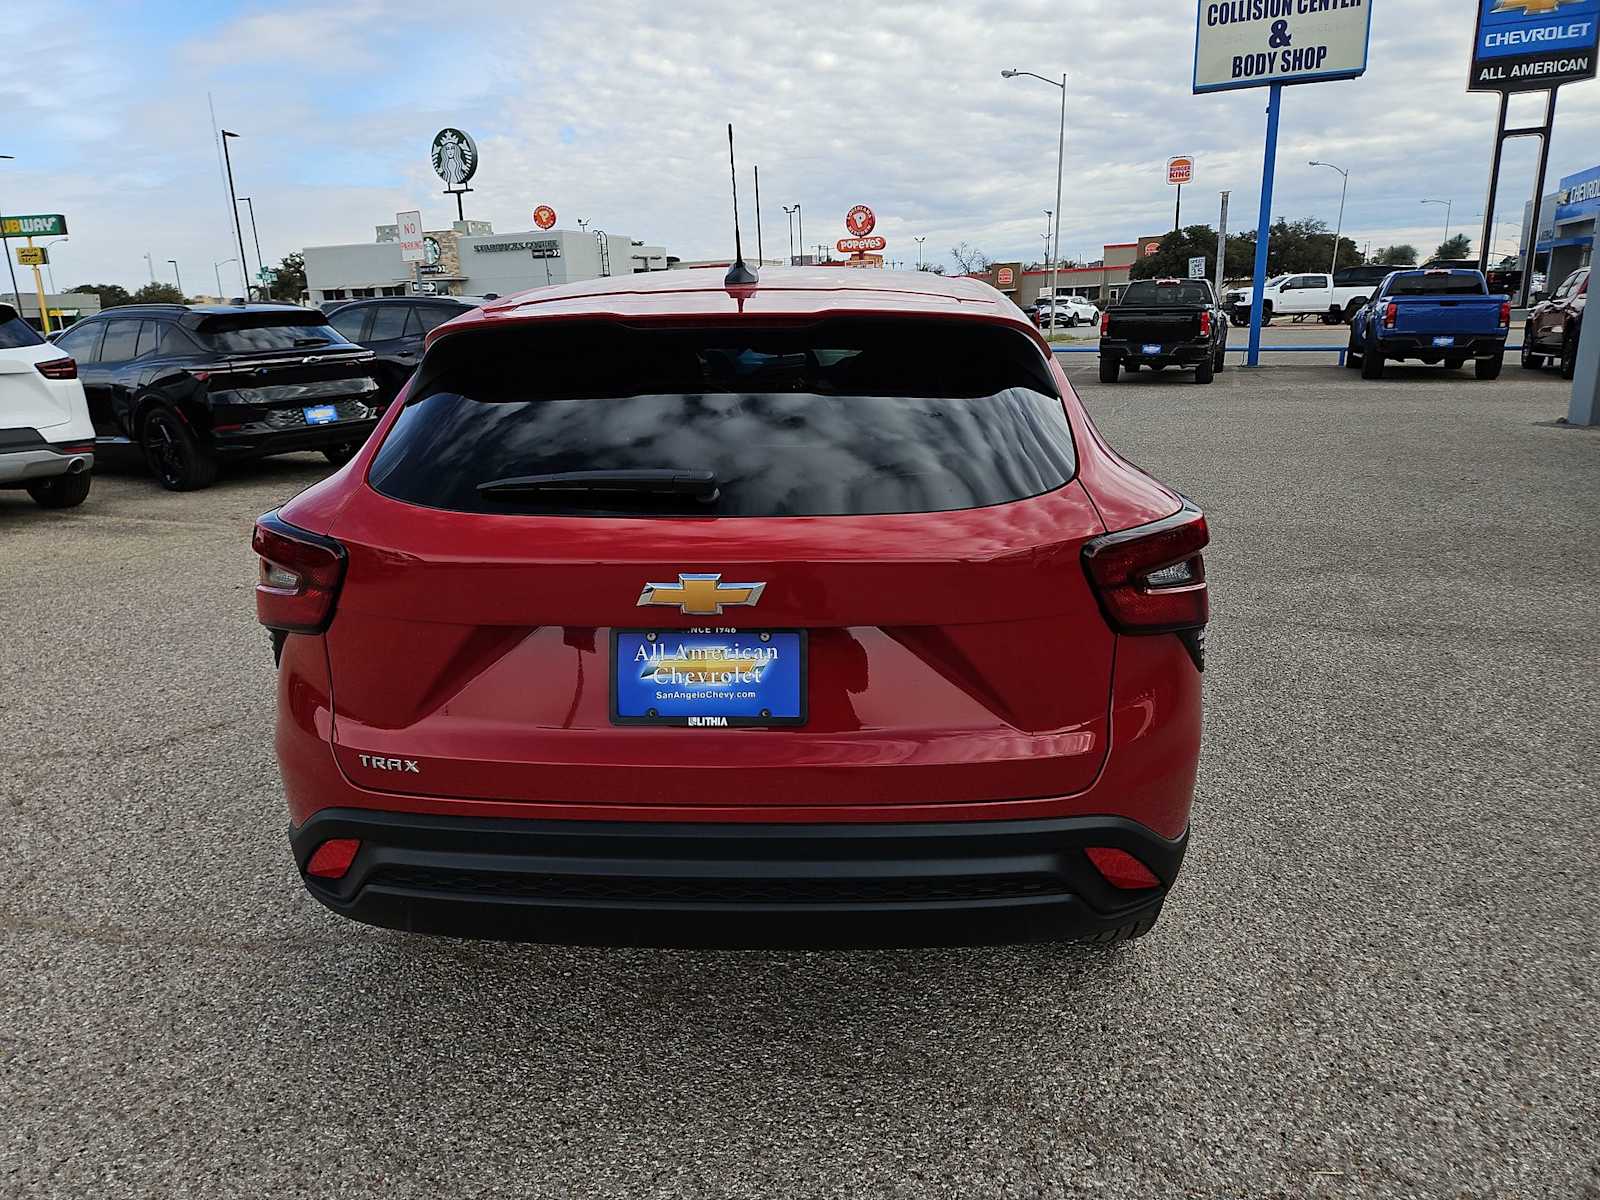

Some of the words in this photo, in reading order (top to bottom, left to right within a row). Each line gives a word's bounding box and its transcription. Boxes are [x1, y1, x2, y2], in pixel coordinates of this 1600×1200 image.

[1207, 0, 1292, 27] COLLISION
[1297, 0, 1361, 14] CEN
[1268, 19, 1292, 49] &
[1484, 22, 1591, 48] CHEVROLET
[1231, 52, 1277, 78] BODY
[1280, 46, 1327, 73] SHOP
[1480, 66, 1506, 81] ALL
[1510, 57, 1588, 78] AMERICAN
[0, 216, 57, 235] UBWAY
[404, 222, 416, 235] NO
[400, 240, 423, 250] PARKING
[1191, 268, 1204, 276] 35
[634, 642, 665, 662] All
[673, 643, 778, 661] American
[653, 665, 762, 685] Chevrolet
[656, 690, 756, 700] SanAngeloChevy.com
[697, 716, 728, 727] LITHIA
[358, 754, 420, 773] TRAX
